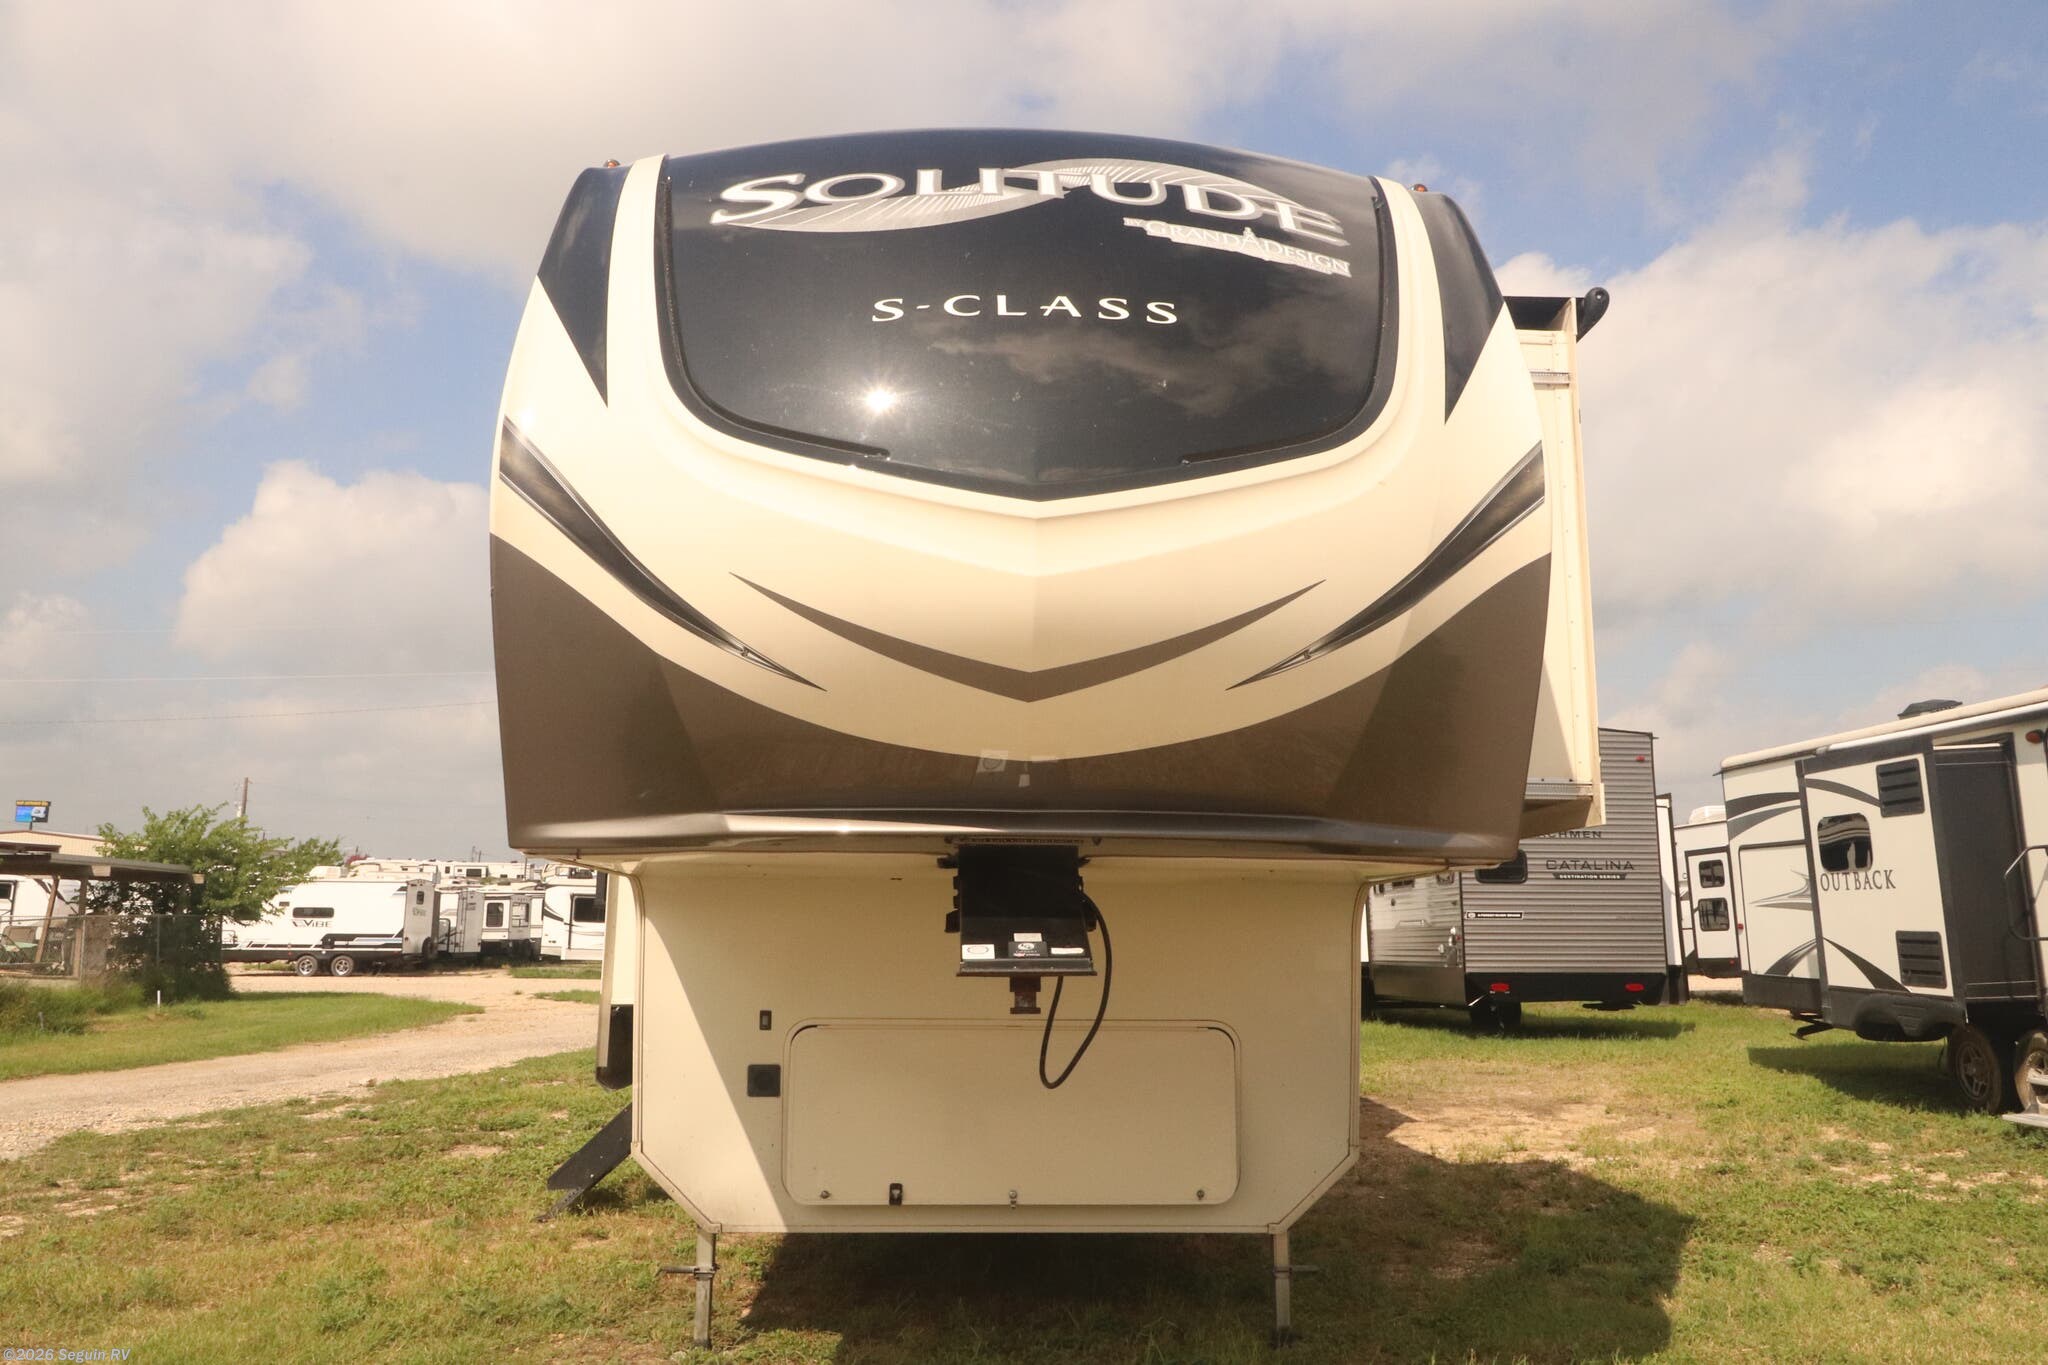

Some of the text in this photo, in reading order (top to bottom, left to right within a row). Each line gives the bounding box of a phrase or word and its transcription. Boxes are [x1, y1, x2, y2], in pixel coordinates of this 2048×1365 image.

[710, 168, 1350, 247] SOLITUDE
[872, 294, 1177, 324] S-CLASS
[1545, 859, 1635, 870] CATALINA
[1820, 869, 1896, 892] OUTBACK
